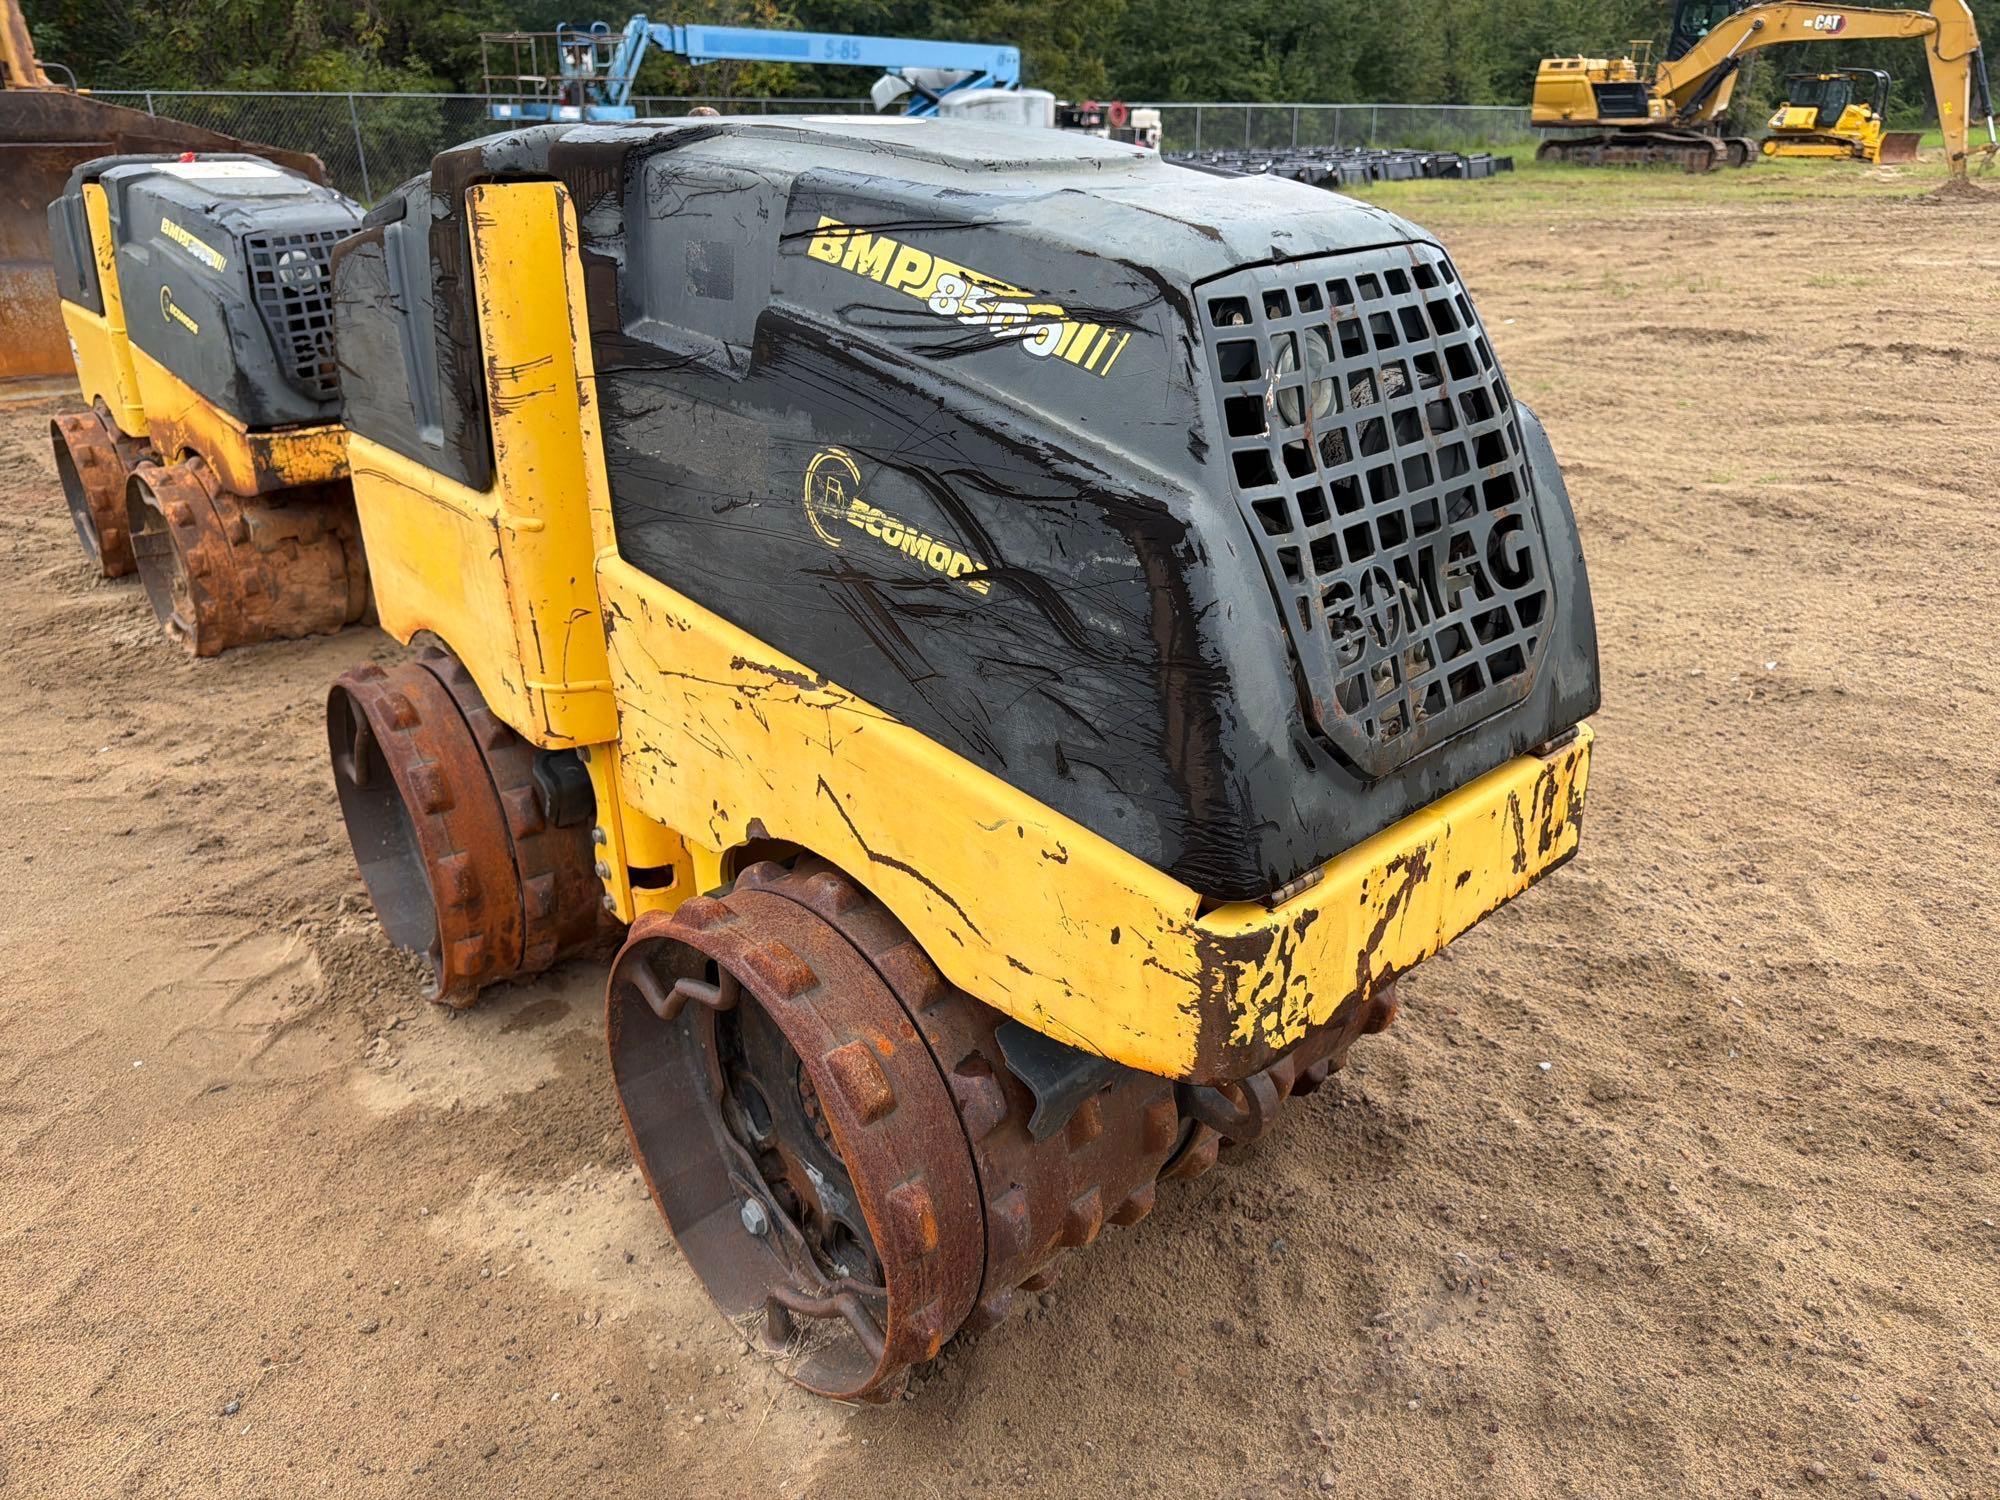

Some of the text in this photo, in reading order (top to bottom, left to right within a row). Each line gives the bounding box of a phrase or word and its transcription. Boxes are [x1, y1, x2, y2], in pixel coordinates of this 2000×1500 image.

[1814, 14, 1842, 30] CAT
[824, 39, 861, 60] S-85
[1321, 513, 1535, 669] BOMAG
